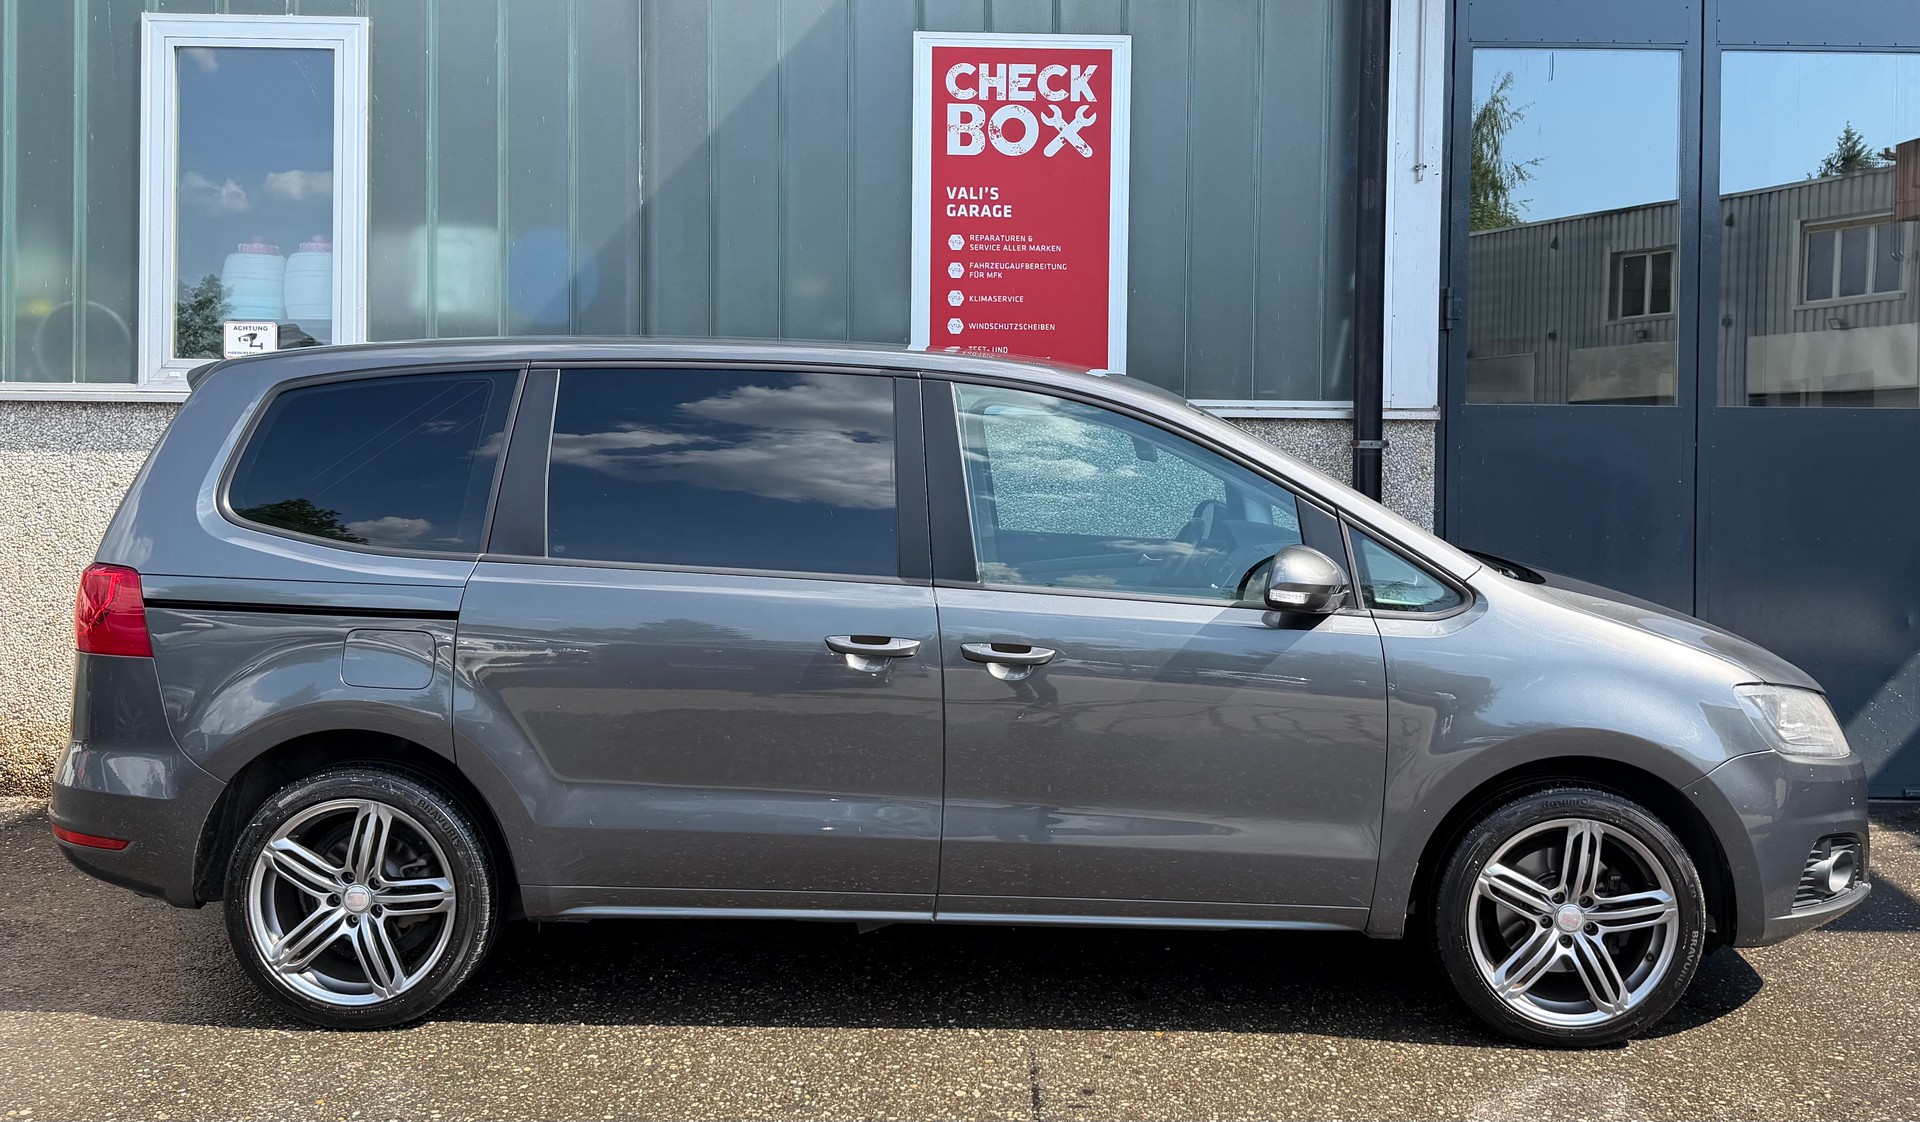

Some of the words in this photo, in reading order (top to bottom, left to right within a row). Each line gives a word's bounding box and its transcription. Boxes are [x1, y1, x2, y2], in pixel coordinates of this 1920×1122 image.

[945, 62, 1098, 102] CHECK
[946, 103, 1097, 158] BOX
[946, 186, 999, 200] VALI'S
[946, 204, 1012, 218] GARAGE
[969, 234, 1026, 242] REPARATUREN
[1003, 244, 1027, 252] ALLER
[969, 262, 1067, 270] FAHRZEUGAUFBEREITUNG
[969, 271, 985, 279] FÜR
[986, 271, 1003, 279] MFK
[969, 295, 1024, 303] KLIMASERVICE
[968, 322, 1056, 331] WINDSCHUTZSCHEIBEN
